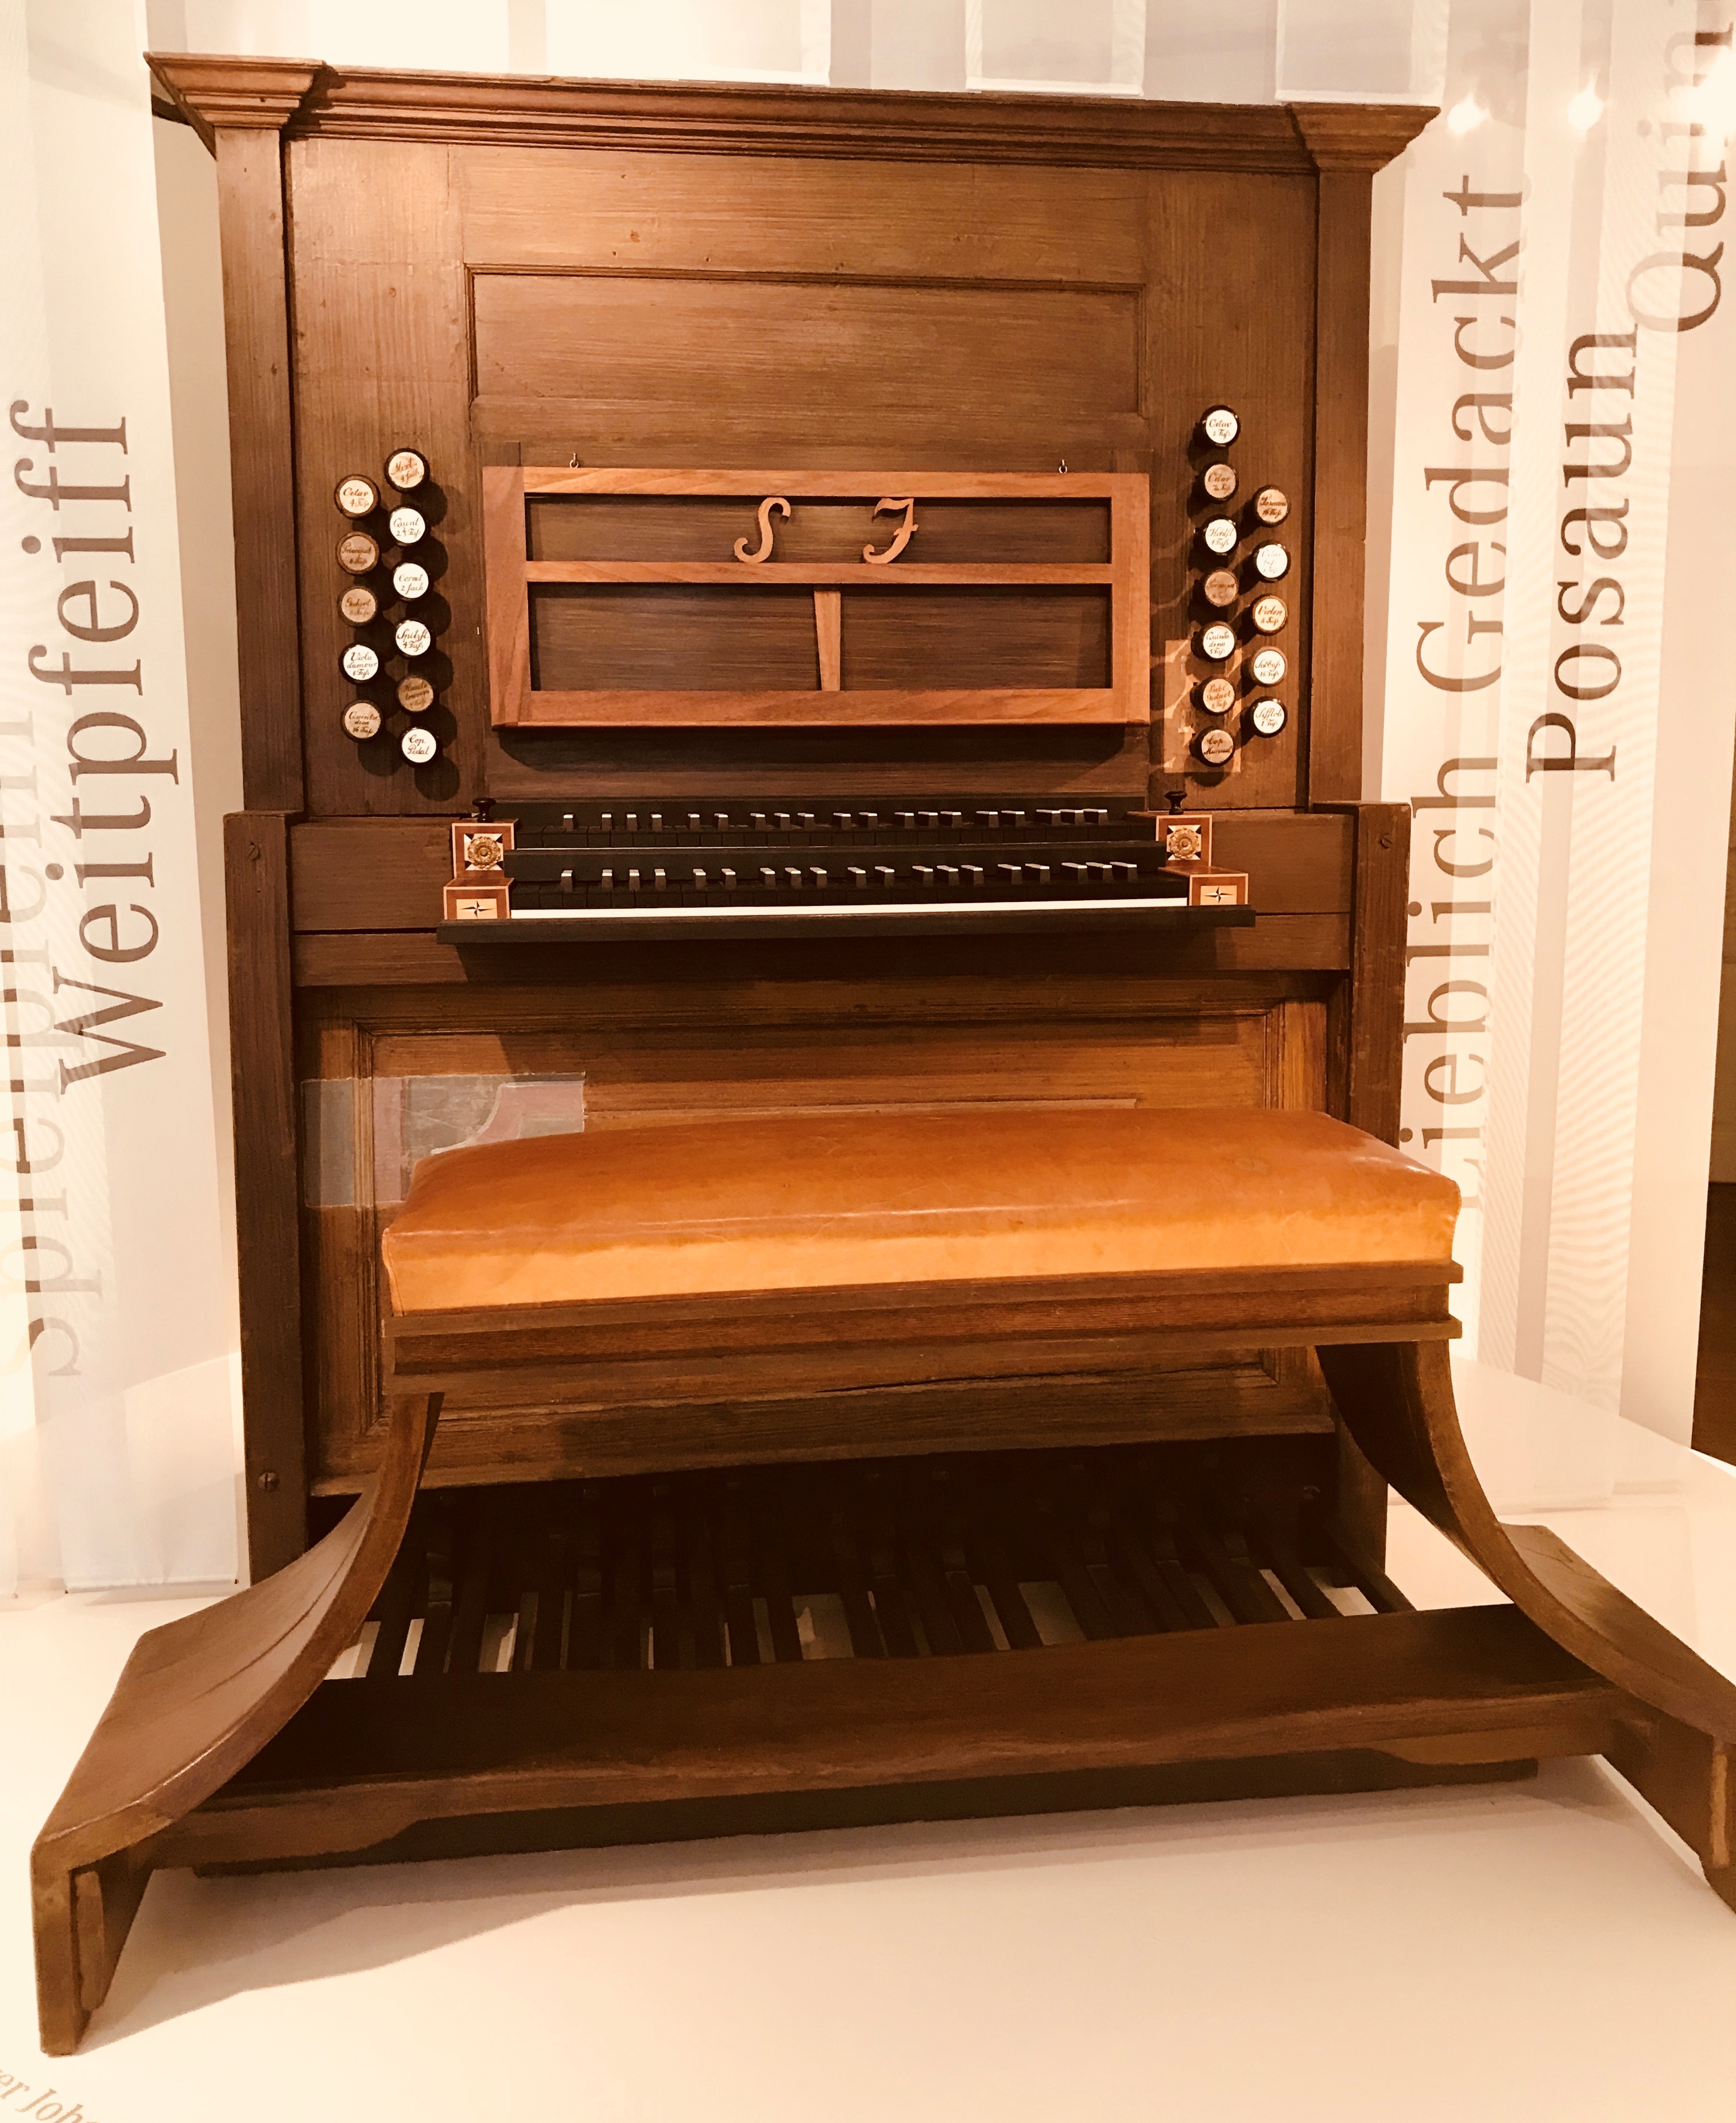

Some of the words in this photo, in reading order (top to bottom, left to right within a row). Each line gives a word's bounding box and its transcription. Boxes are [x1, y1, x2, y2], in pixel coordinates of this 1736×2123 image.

[1416, 175, 1523, 692] Gedackt
[1526, 323, 1637, 783] Posaun
[10, 400, 179, 1095] Weitpfeiff
[351, 652, 372, 661] Viola
[407, 744, 429, 755] Pedal
[15, 2089, 100, 2123] Joh
